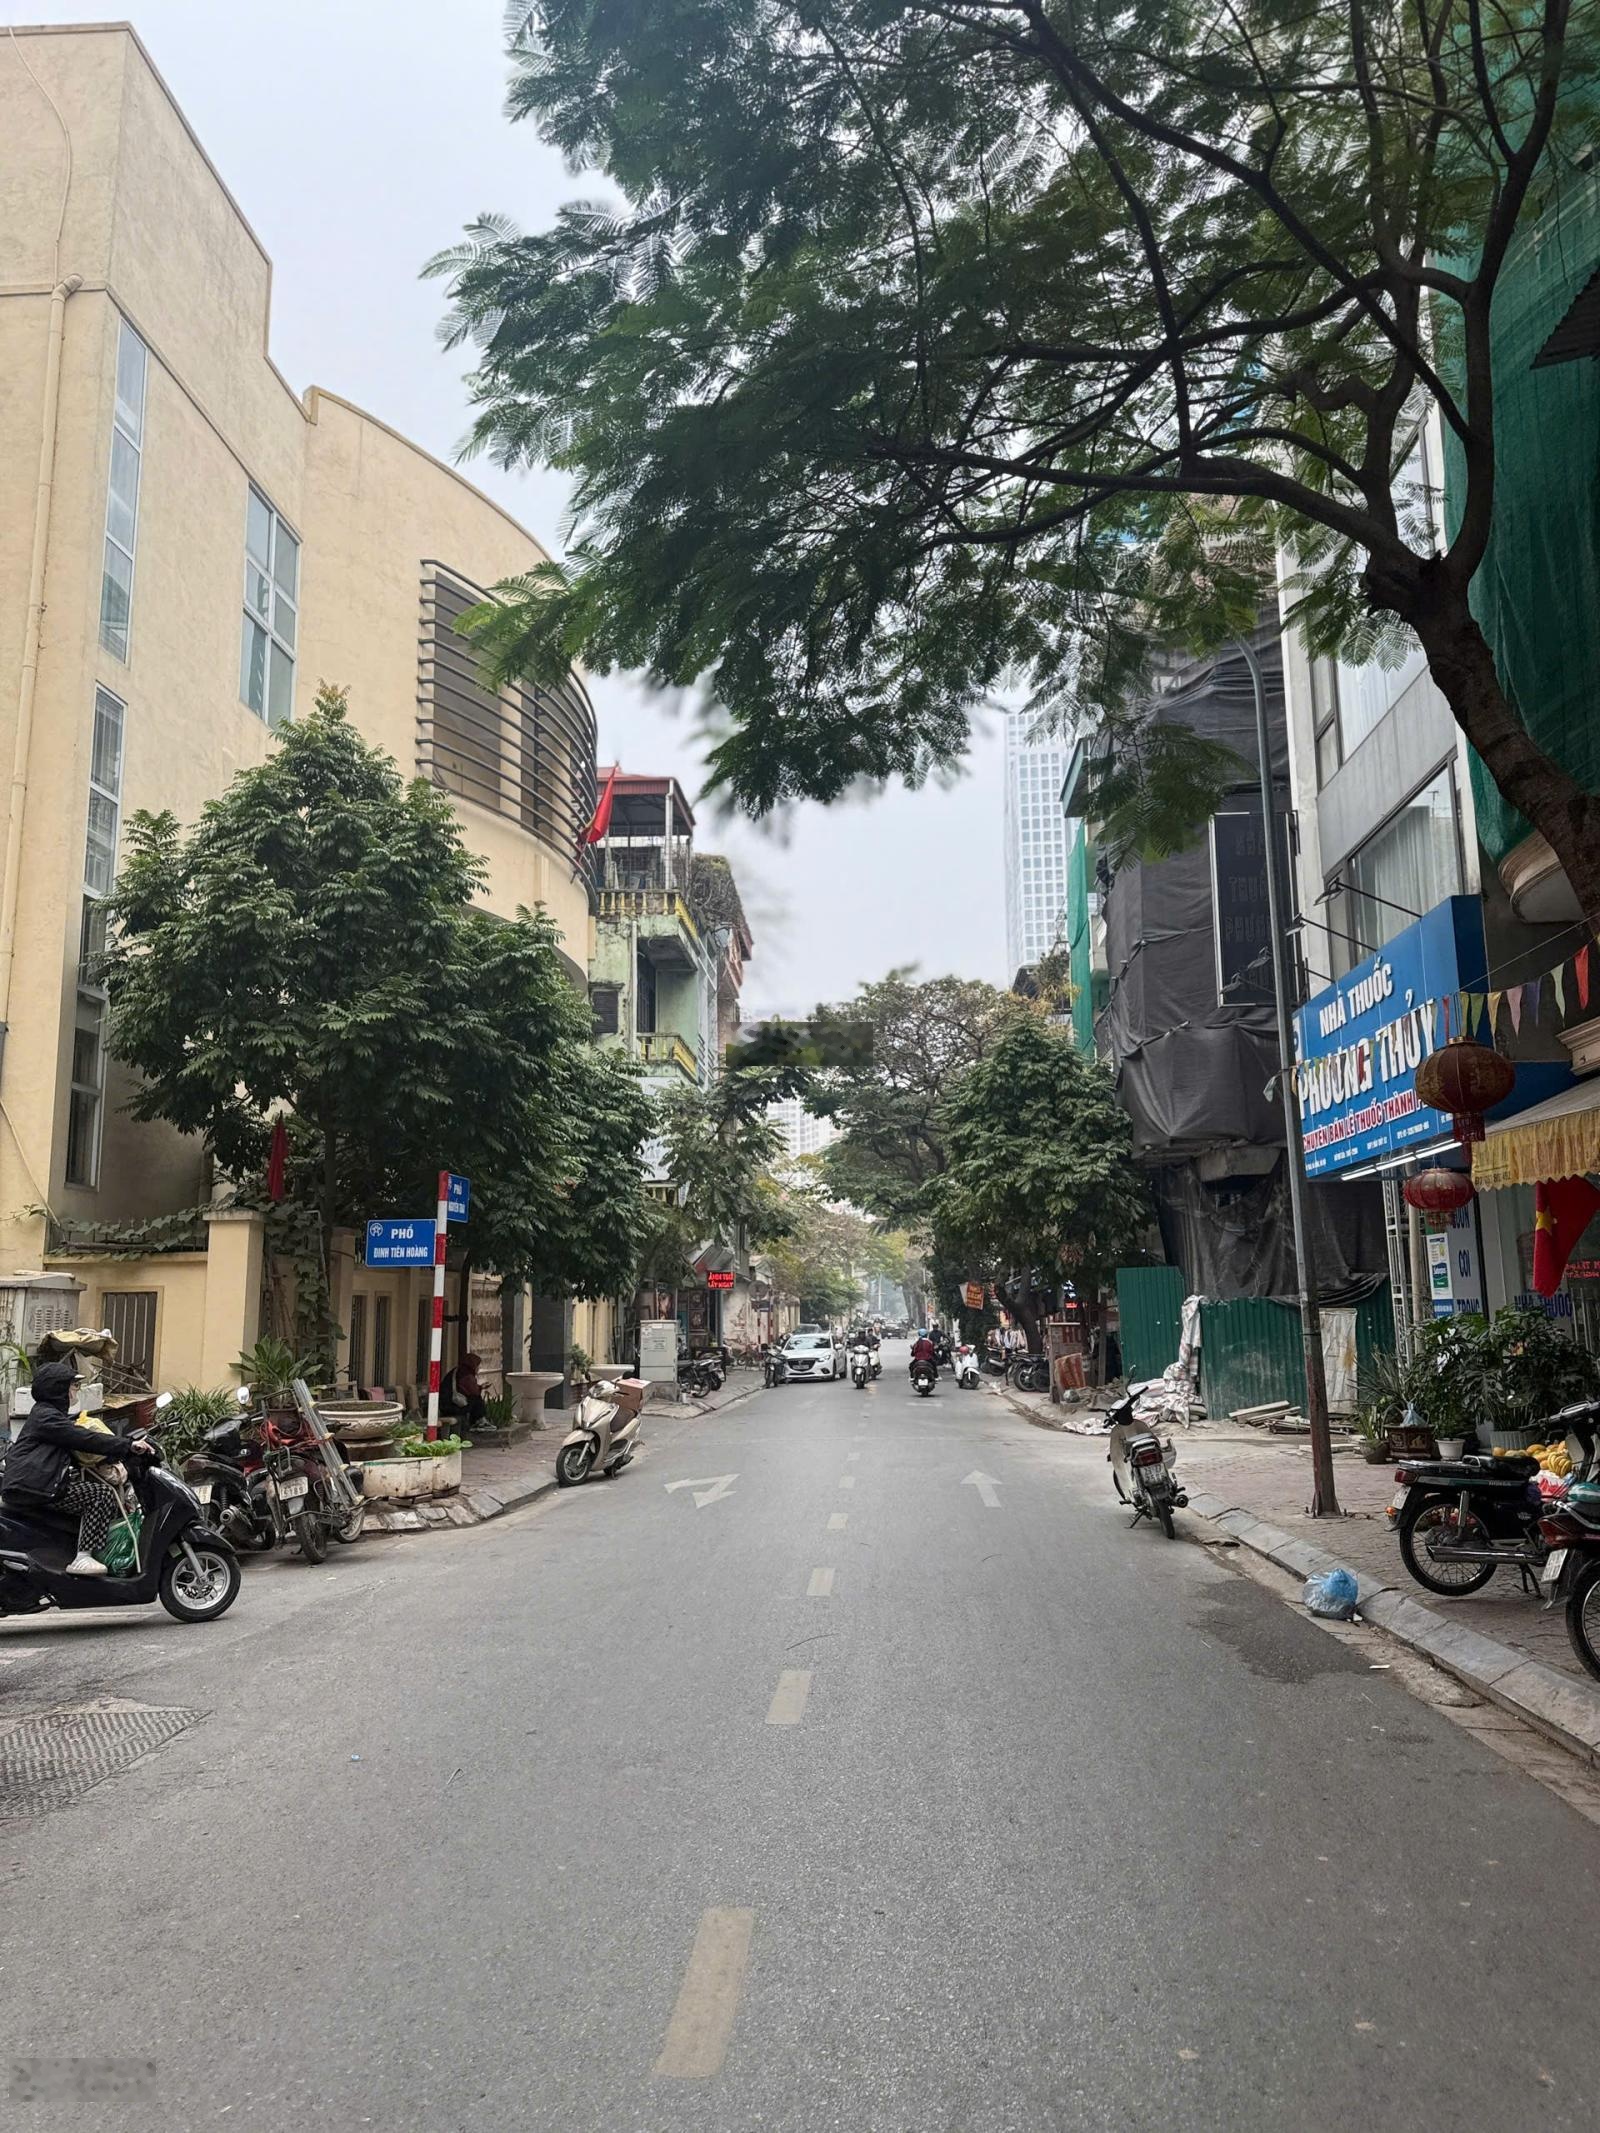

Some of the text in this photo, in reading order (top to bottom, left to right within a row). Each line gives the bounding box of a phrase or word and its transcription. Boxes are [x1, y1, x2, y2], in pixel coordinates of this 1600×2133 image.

[1319, 956, 1393, 1038] NHÀ THUỐC
[1297, 988, 1436, 1120] PHƯƠNG THỦY
[1328, 1116, 1346, 1145] BÁN
[1354, 1096, 1384, 1134] THUỐC
[1382, 1090, 1416, 1123] THÀNH
[390, 1223, 414, 1240] PHỐ
[390, 1245, 405, 1259] TIÊN
[406, 1244, 428, 1258] HOÀNG
